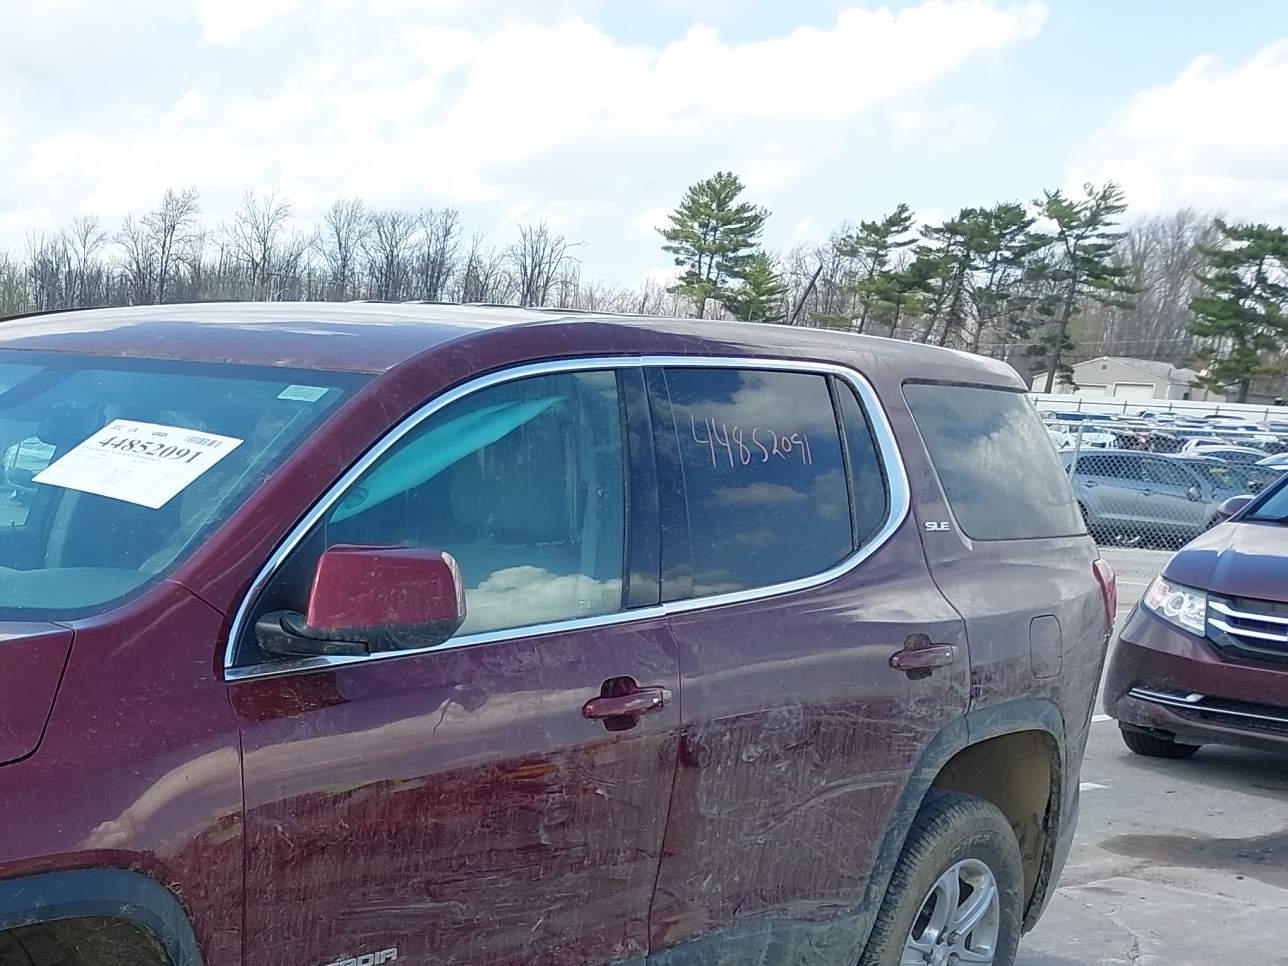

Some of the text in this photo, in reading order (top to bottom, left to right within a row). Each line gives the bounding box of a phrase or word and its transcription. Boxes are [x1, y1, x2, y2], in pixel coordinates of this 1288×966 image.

[98, 435, 204, 464] 44852091
[691, 414, 812, 469] 44852091
[924, 520, 952, 532] SLE
